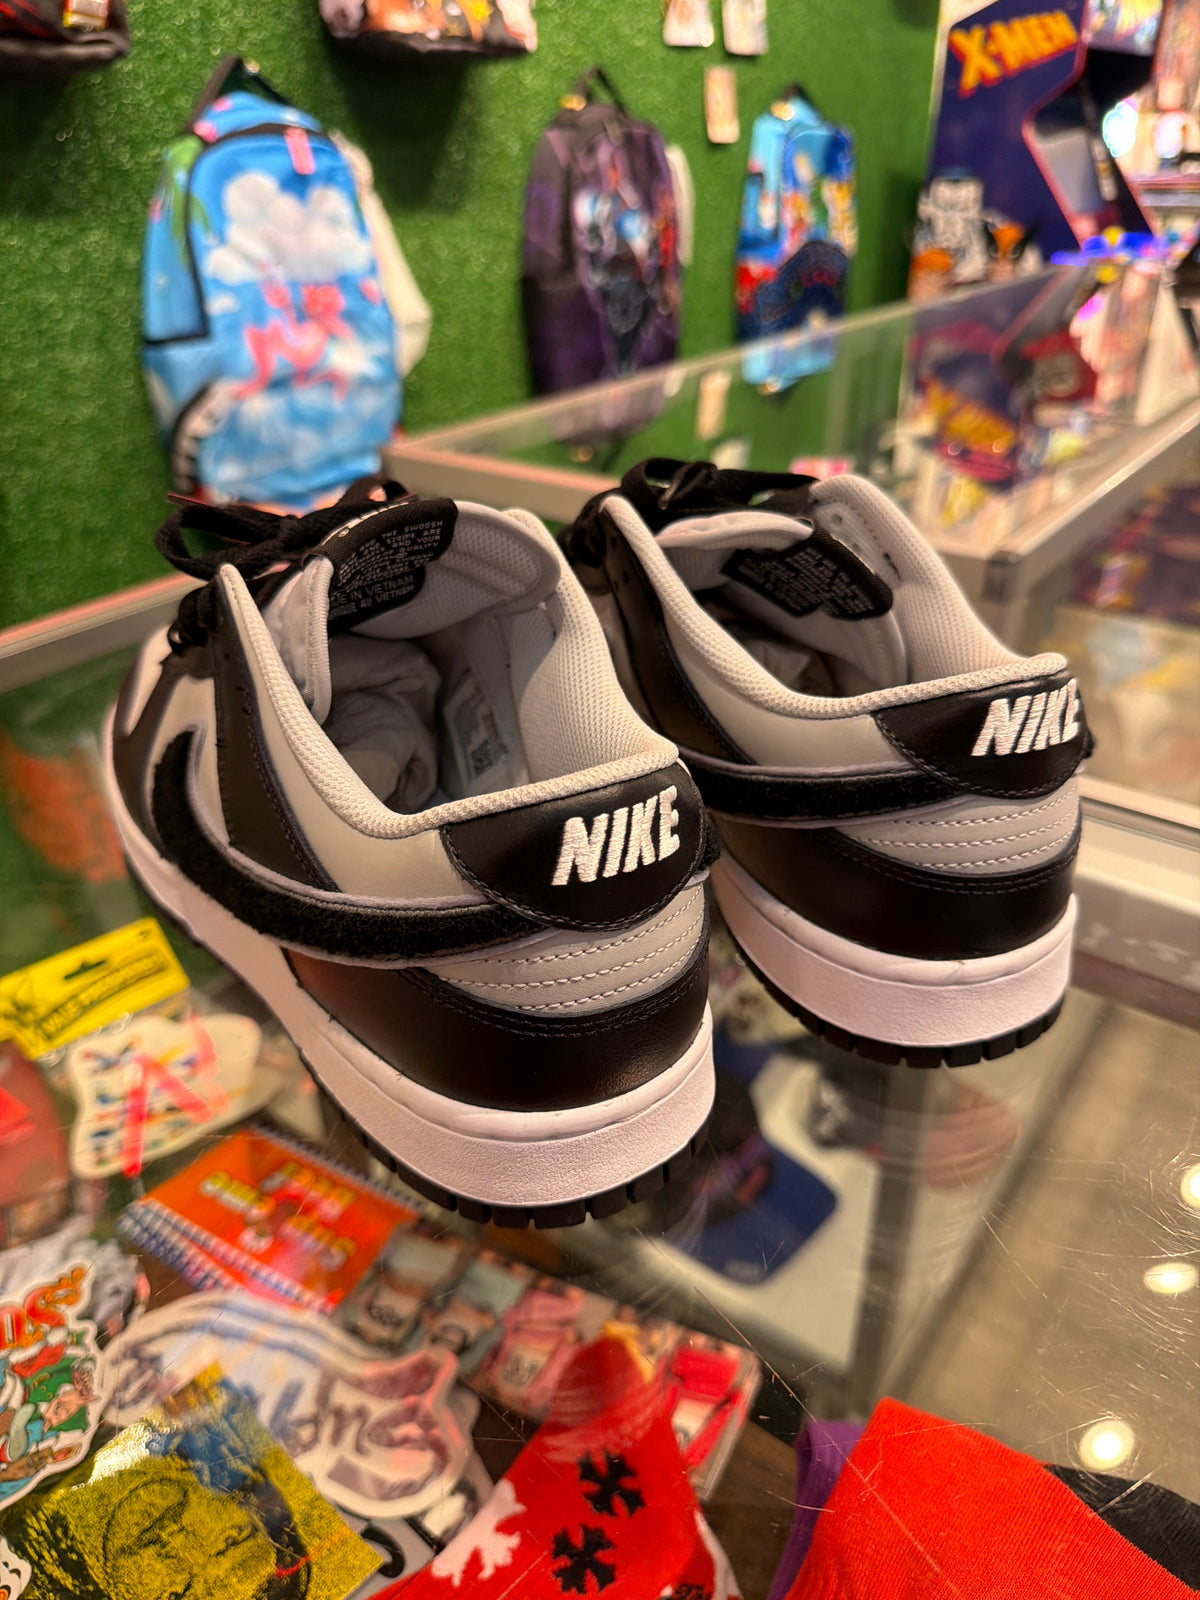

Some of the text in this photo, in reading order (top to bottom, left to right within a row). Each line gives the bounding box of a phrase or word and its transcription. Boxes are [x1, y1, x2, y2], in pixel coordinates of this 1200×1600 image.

[948, 10, 1078, 97] X-MEN
[404, 520, 443, 532] SWOOSH
[365, 574, 414, 596] VIETNAM
[375, 585, 415, 604] VIETNAM
[971, 678, 1080, 757] NIKE
[551, 785, 680, 886] NIKE
